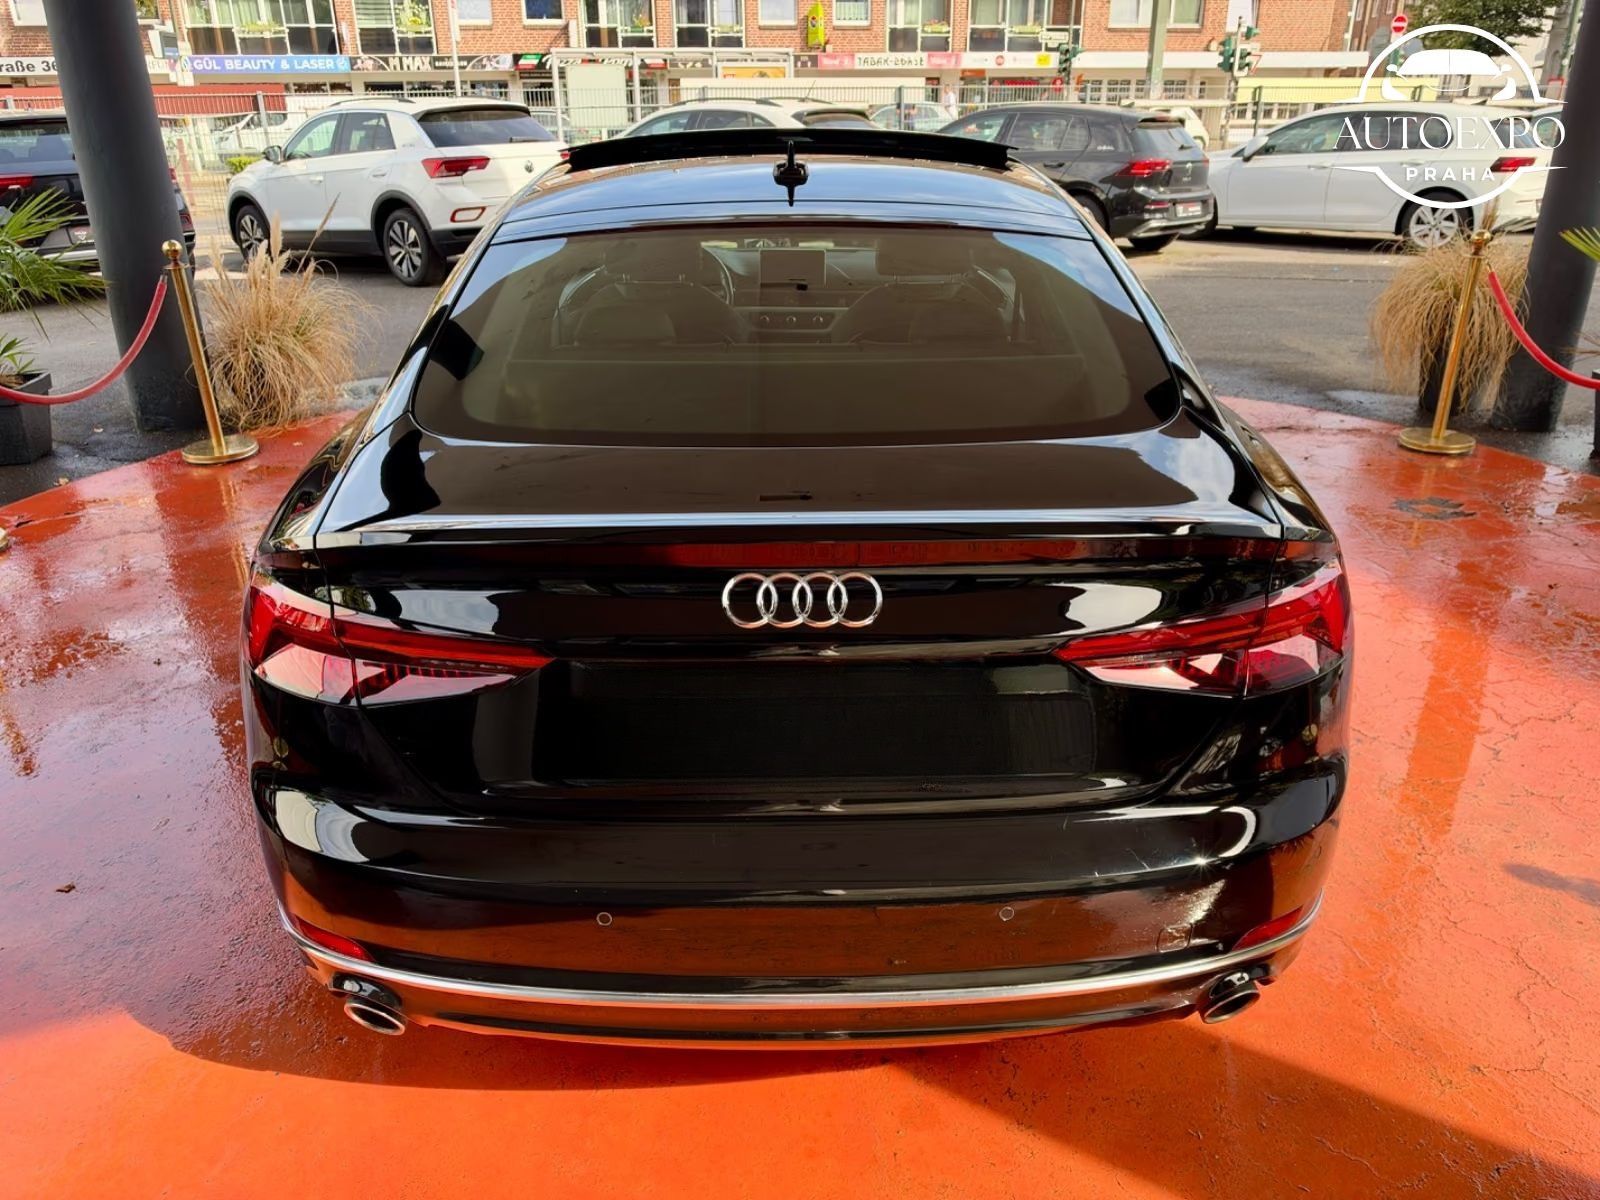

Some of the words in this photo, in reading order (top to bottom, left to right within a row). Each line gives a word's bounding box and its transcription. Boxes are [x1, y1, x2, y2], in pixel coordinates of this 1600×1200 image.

[225, 59, 275, 70] BEAUTY
[281, 59, 290, 70] &
[294, 59, 335, 70] LASER
